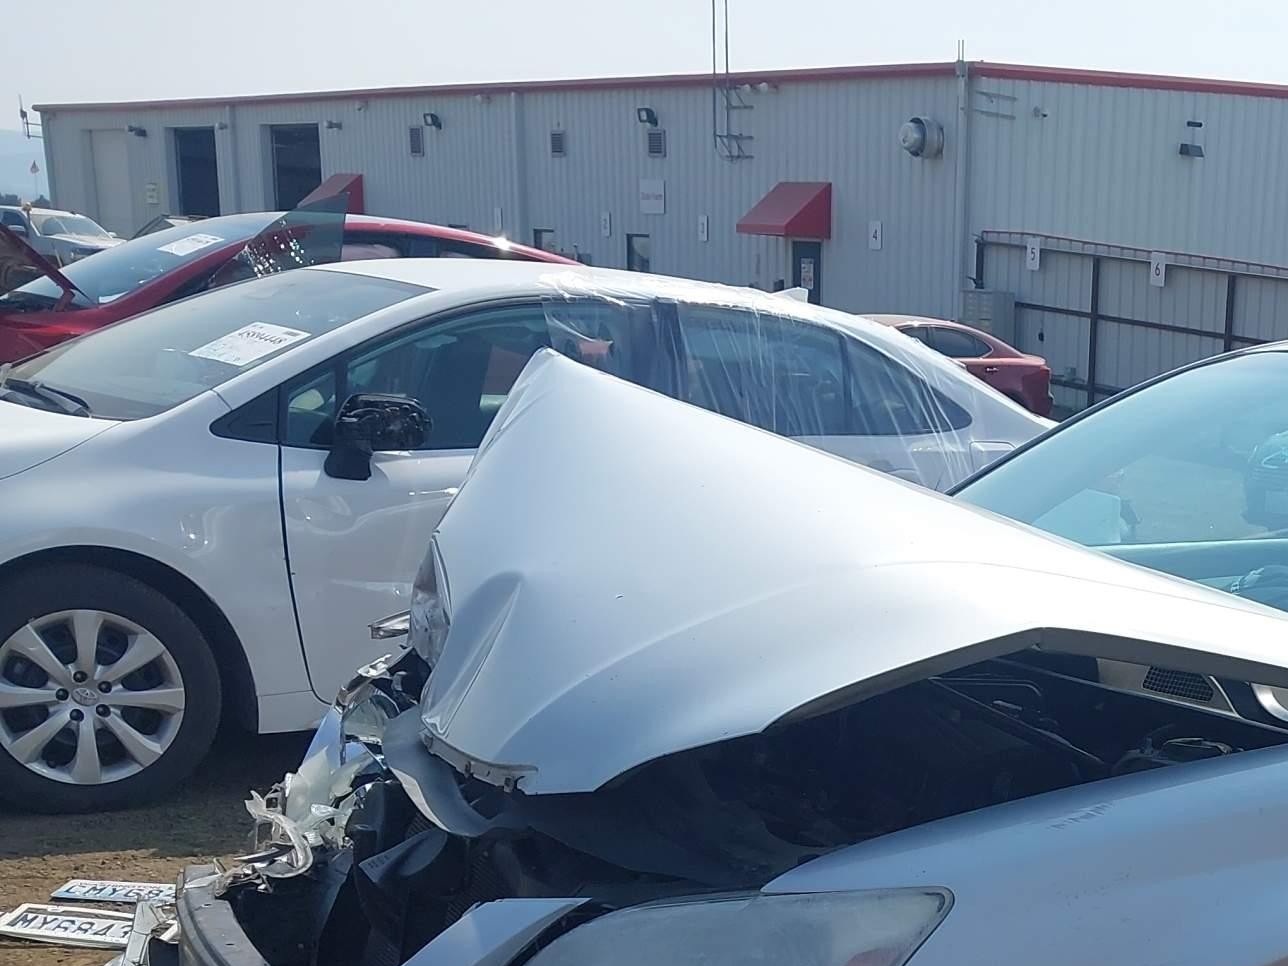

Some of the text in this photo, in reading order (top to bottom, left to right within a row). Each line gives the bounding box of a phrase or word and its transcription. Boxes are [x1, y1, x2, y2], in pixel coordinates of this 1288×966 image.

[872, 228, 878, 241] 4
[1030, 247, 1037, 261] 5
[1154, 262, 1161, 277] 6
